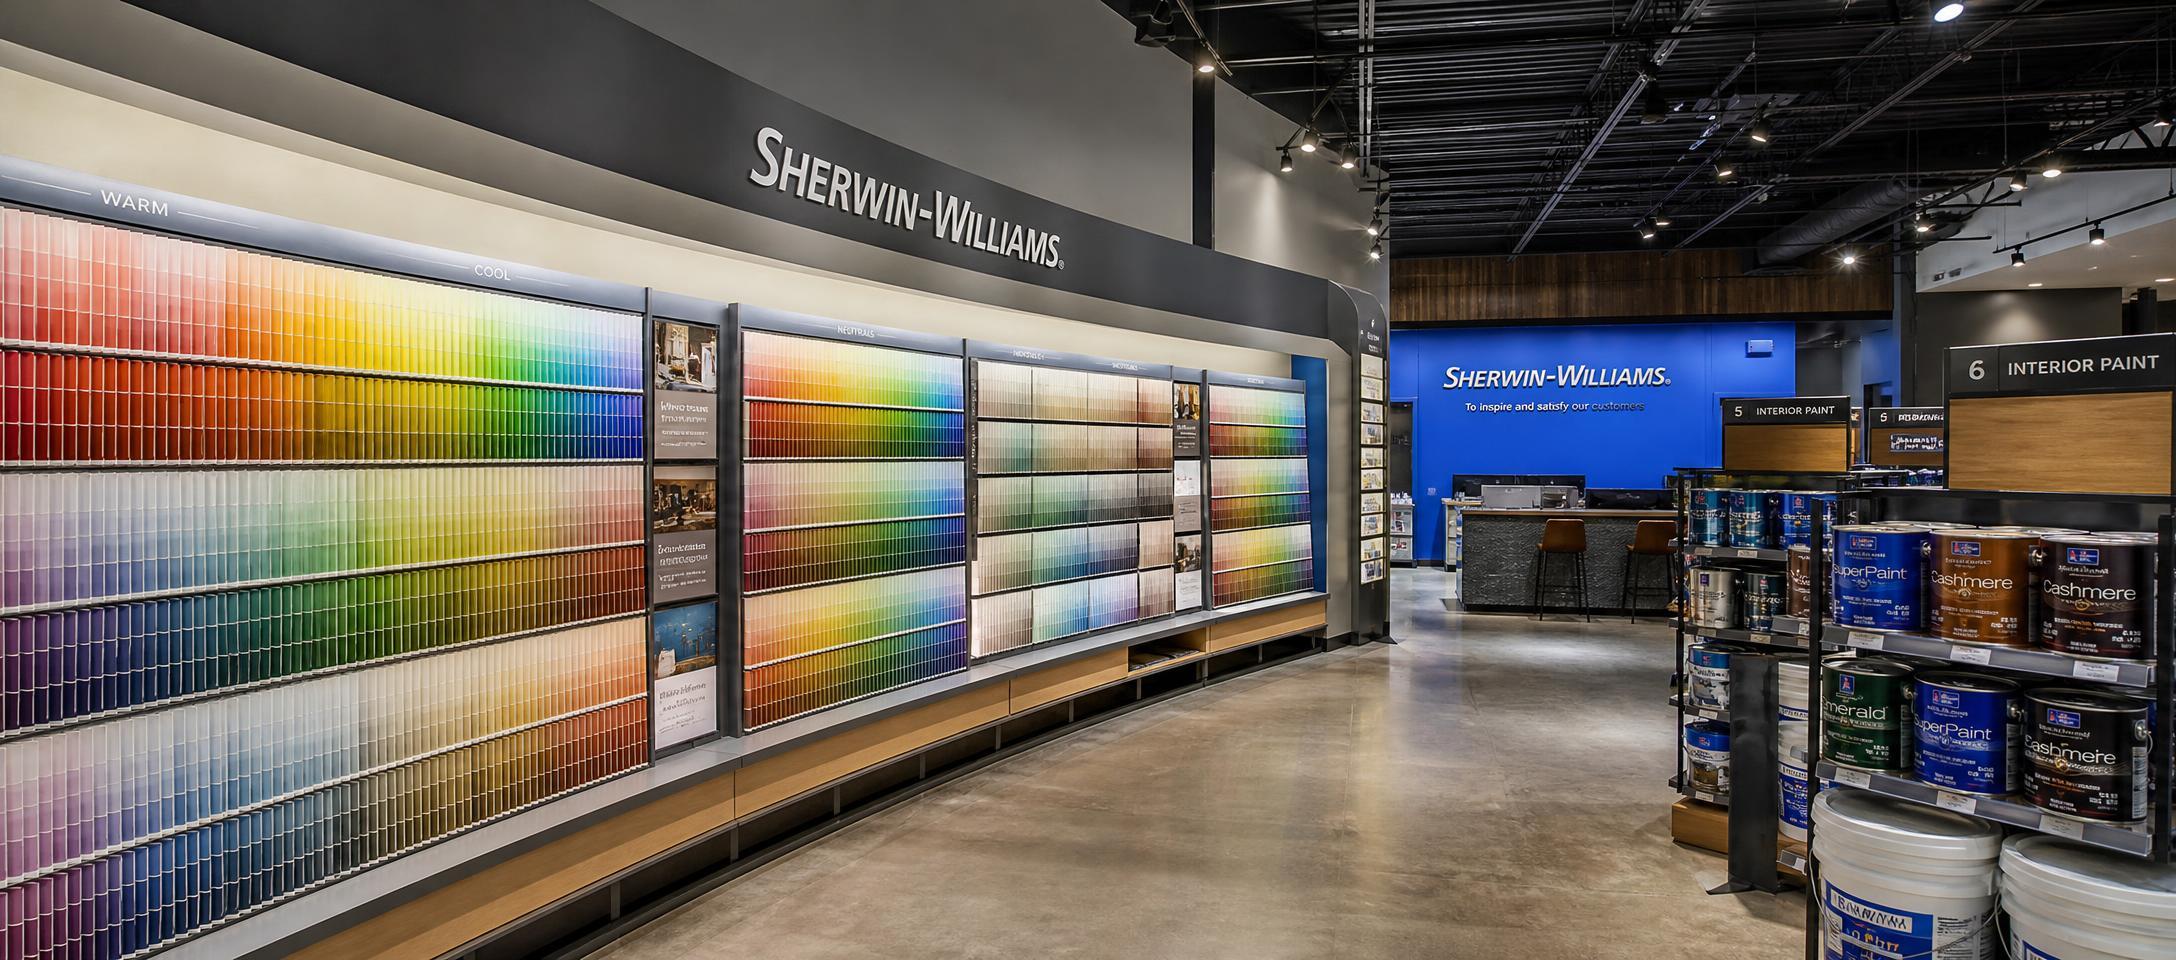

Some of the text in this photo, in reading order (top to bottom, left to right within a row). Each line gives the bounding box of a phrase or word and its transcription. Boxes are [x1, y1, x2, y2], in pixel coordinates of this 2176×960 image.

[100, 189, 168, 217] WARM
[474, 264, 511, 281] COOL
[1968, 354, 2160, 381] 6 INTERIOR PAINT
[1465, 401, 1644, 413] To inspire and satisfy our customers
[1734, 405, 1835, 417] 5 INTERIOR PAINT
[1832, 563, 1908, 580] SuperPaint
[1931, 570, 2013, 590] Cashmere
[2043, 579, 2137, 601] Cashmere
[1914, 713, 1992, 741] SuperPaint
